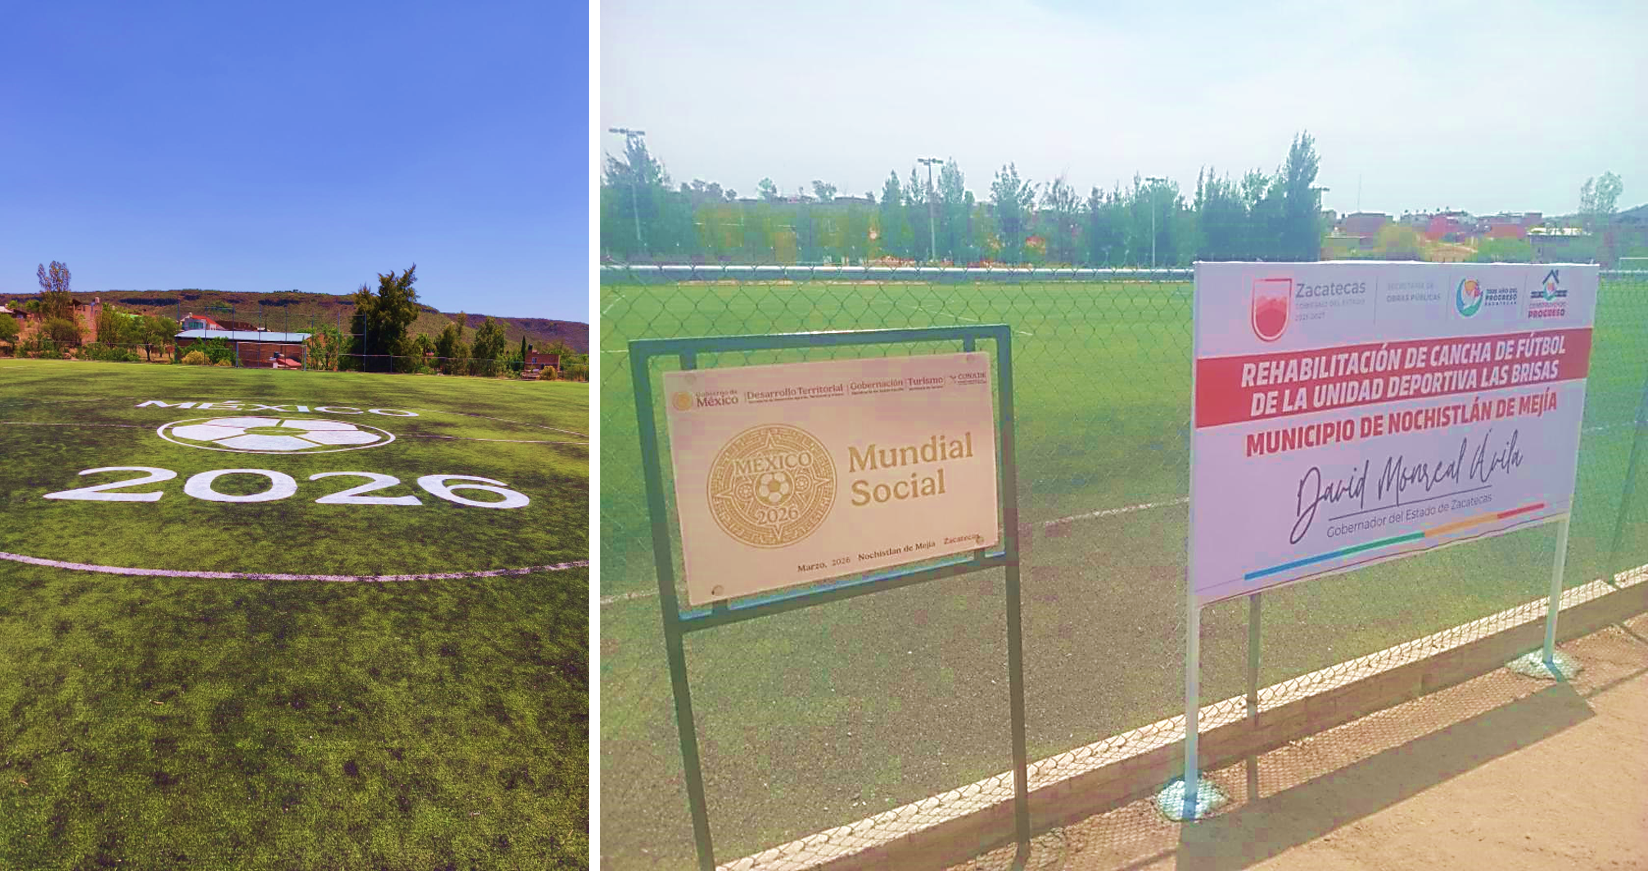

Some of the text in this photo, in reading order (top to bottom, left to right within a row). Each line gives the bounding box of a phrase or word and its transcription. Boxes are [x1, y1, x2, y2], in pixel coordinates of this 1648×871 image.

[1295, 281, 1366, 299] Zacatecas
[1386, 293, 1410, 303] OBRAS
[1485, 293, 1518, 301] PROGRESO
[1527, 308, 1566, 319] PROGRESO
[1241, 331, 1566, 388] REHABILITACIÓN DE CANCHA DE FÚTBOL
[746, 387, 797, 400] Desarrollo
[797, 384, 844, 395] Territorial
[850, 379, 904, 391] Gobernación
[908, 377, 944, 387] Turismo
[1250, 359, 1560, 417] DE LA UNIDAD DEPORTIVA LAS BRISAS
[136, 400, 419, 417] MÉXICO
[696, 394, 739, 408] México
[1246, 386, 1557, 458] MUNICIPIO DE NOCHISTLÁN DE MEJÍA
[734, 451, 812, 474] MÉXICO
[848, 431, 973, 473] Mundial
[42, 466, 530, 509] 2026
[850, 468, 946, 507] Social
[1289, 459, 1369, 545] David
[1378, 437, 1467, 507] Monreal
[756, 505, 799, 525] 2026
[1326, 494, 1493, 538] Gobernador del Estado de Zacatecas
[831, 556, 851, 567] 2026
[903, 544, 913, 553] de
